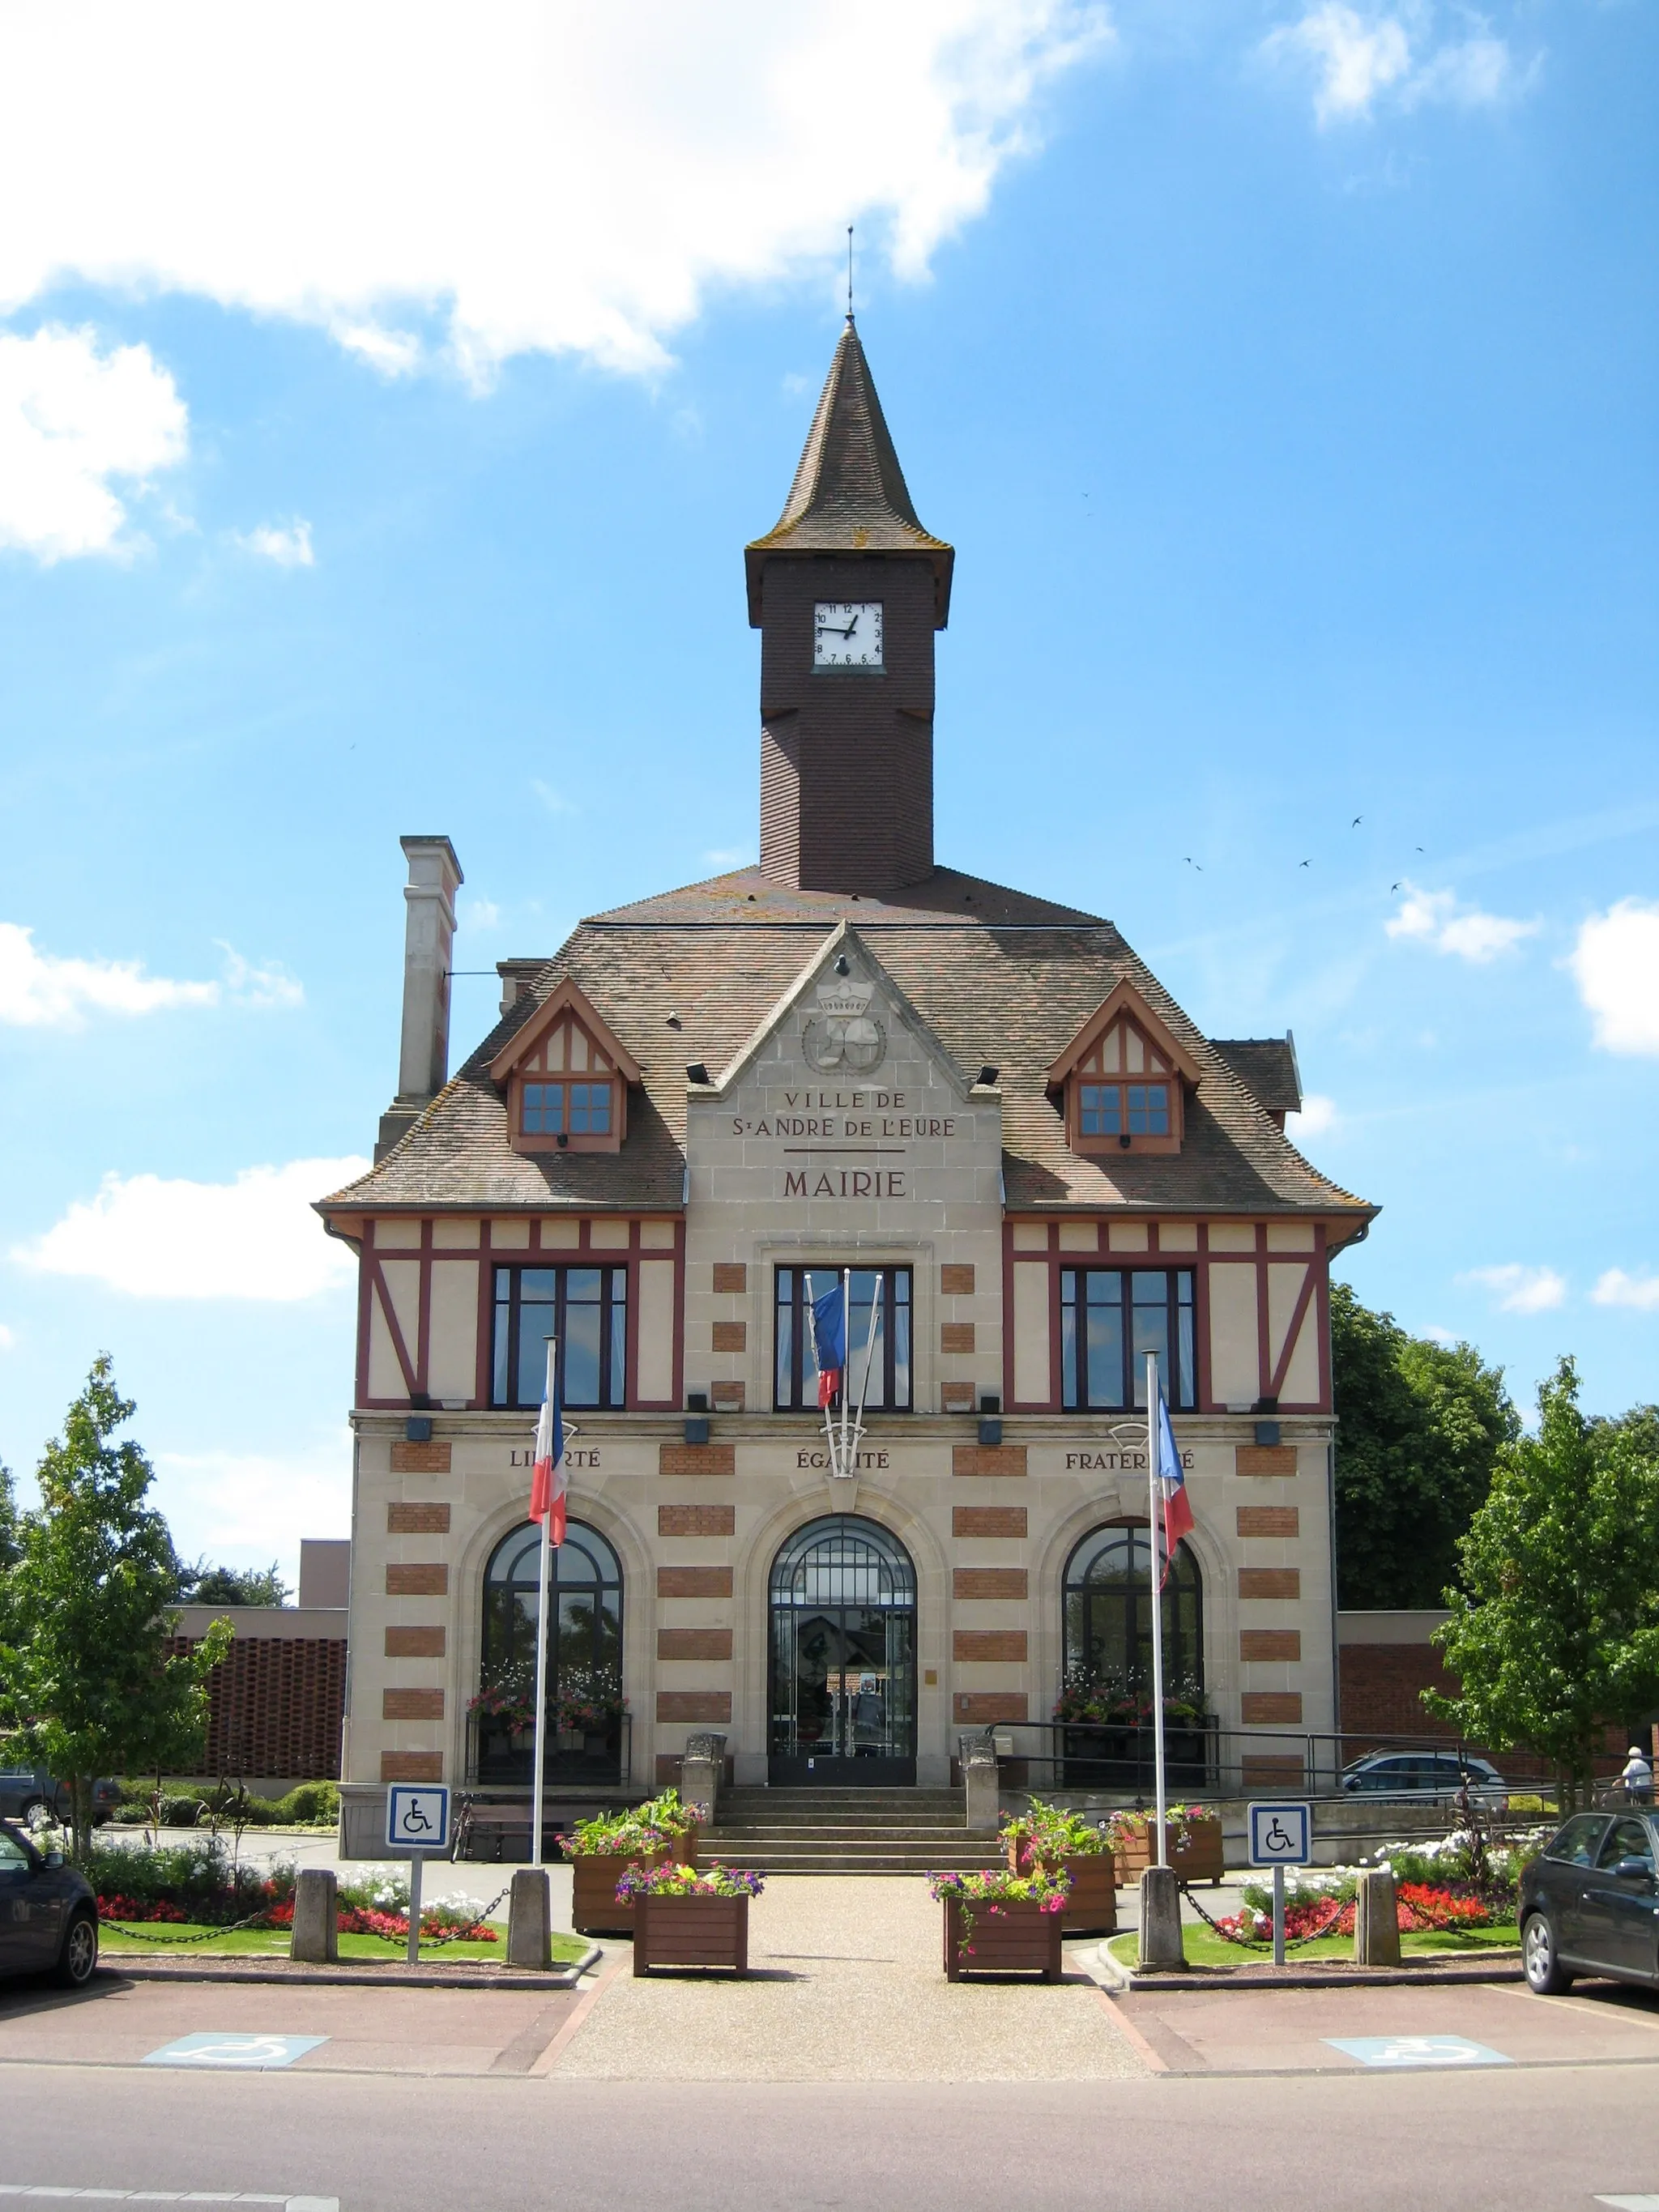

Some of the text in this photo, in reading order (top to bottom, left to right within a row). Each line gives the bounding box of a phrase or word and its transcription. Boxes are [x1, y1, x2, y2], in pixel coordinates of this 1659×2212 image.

[829, 604, 837, 614] 11
[843, 604, 852, 613] 12
[817, 613, 826, 623] 10
[875, 614, 881, 623] 2
[817, 629, 823, 638] 9
[875, 630, 881, 638] 3
[817, 645, 823, 654] 8
[875, 645, 881, 654] 4
[831, 654, 837, 663] 7
[846, 654, 851, 663] 6
[862, 654, 867, 663] 5
[784, 1092, 906, 1109] VILLE DE
[845, 1120, 873, 1137] DE
[881, 1118, 956, 1137] L'EURE
[783, 1170, 906, 1198] MAIRIE
[510, 1447, 601, 1468] LIRTÉ
[1065, 1449, 1195, 1469] FRATERÉ
